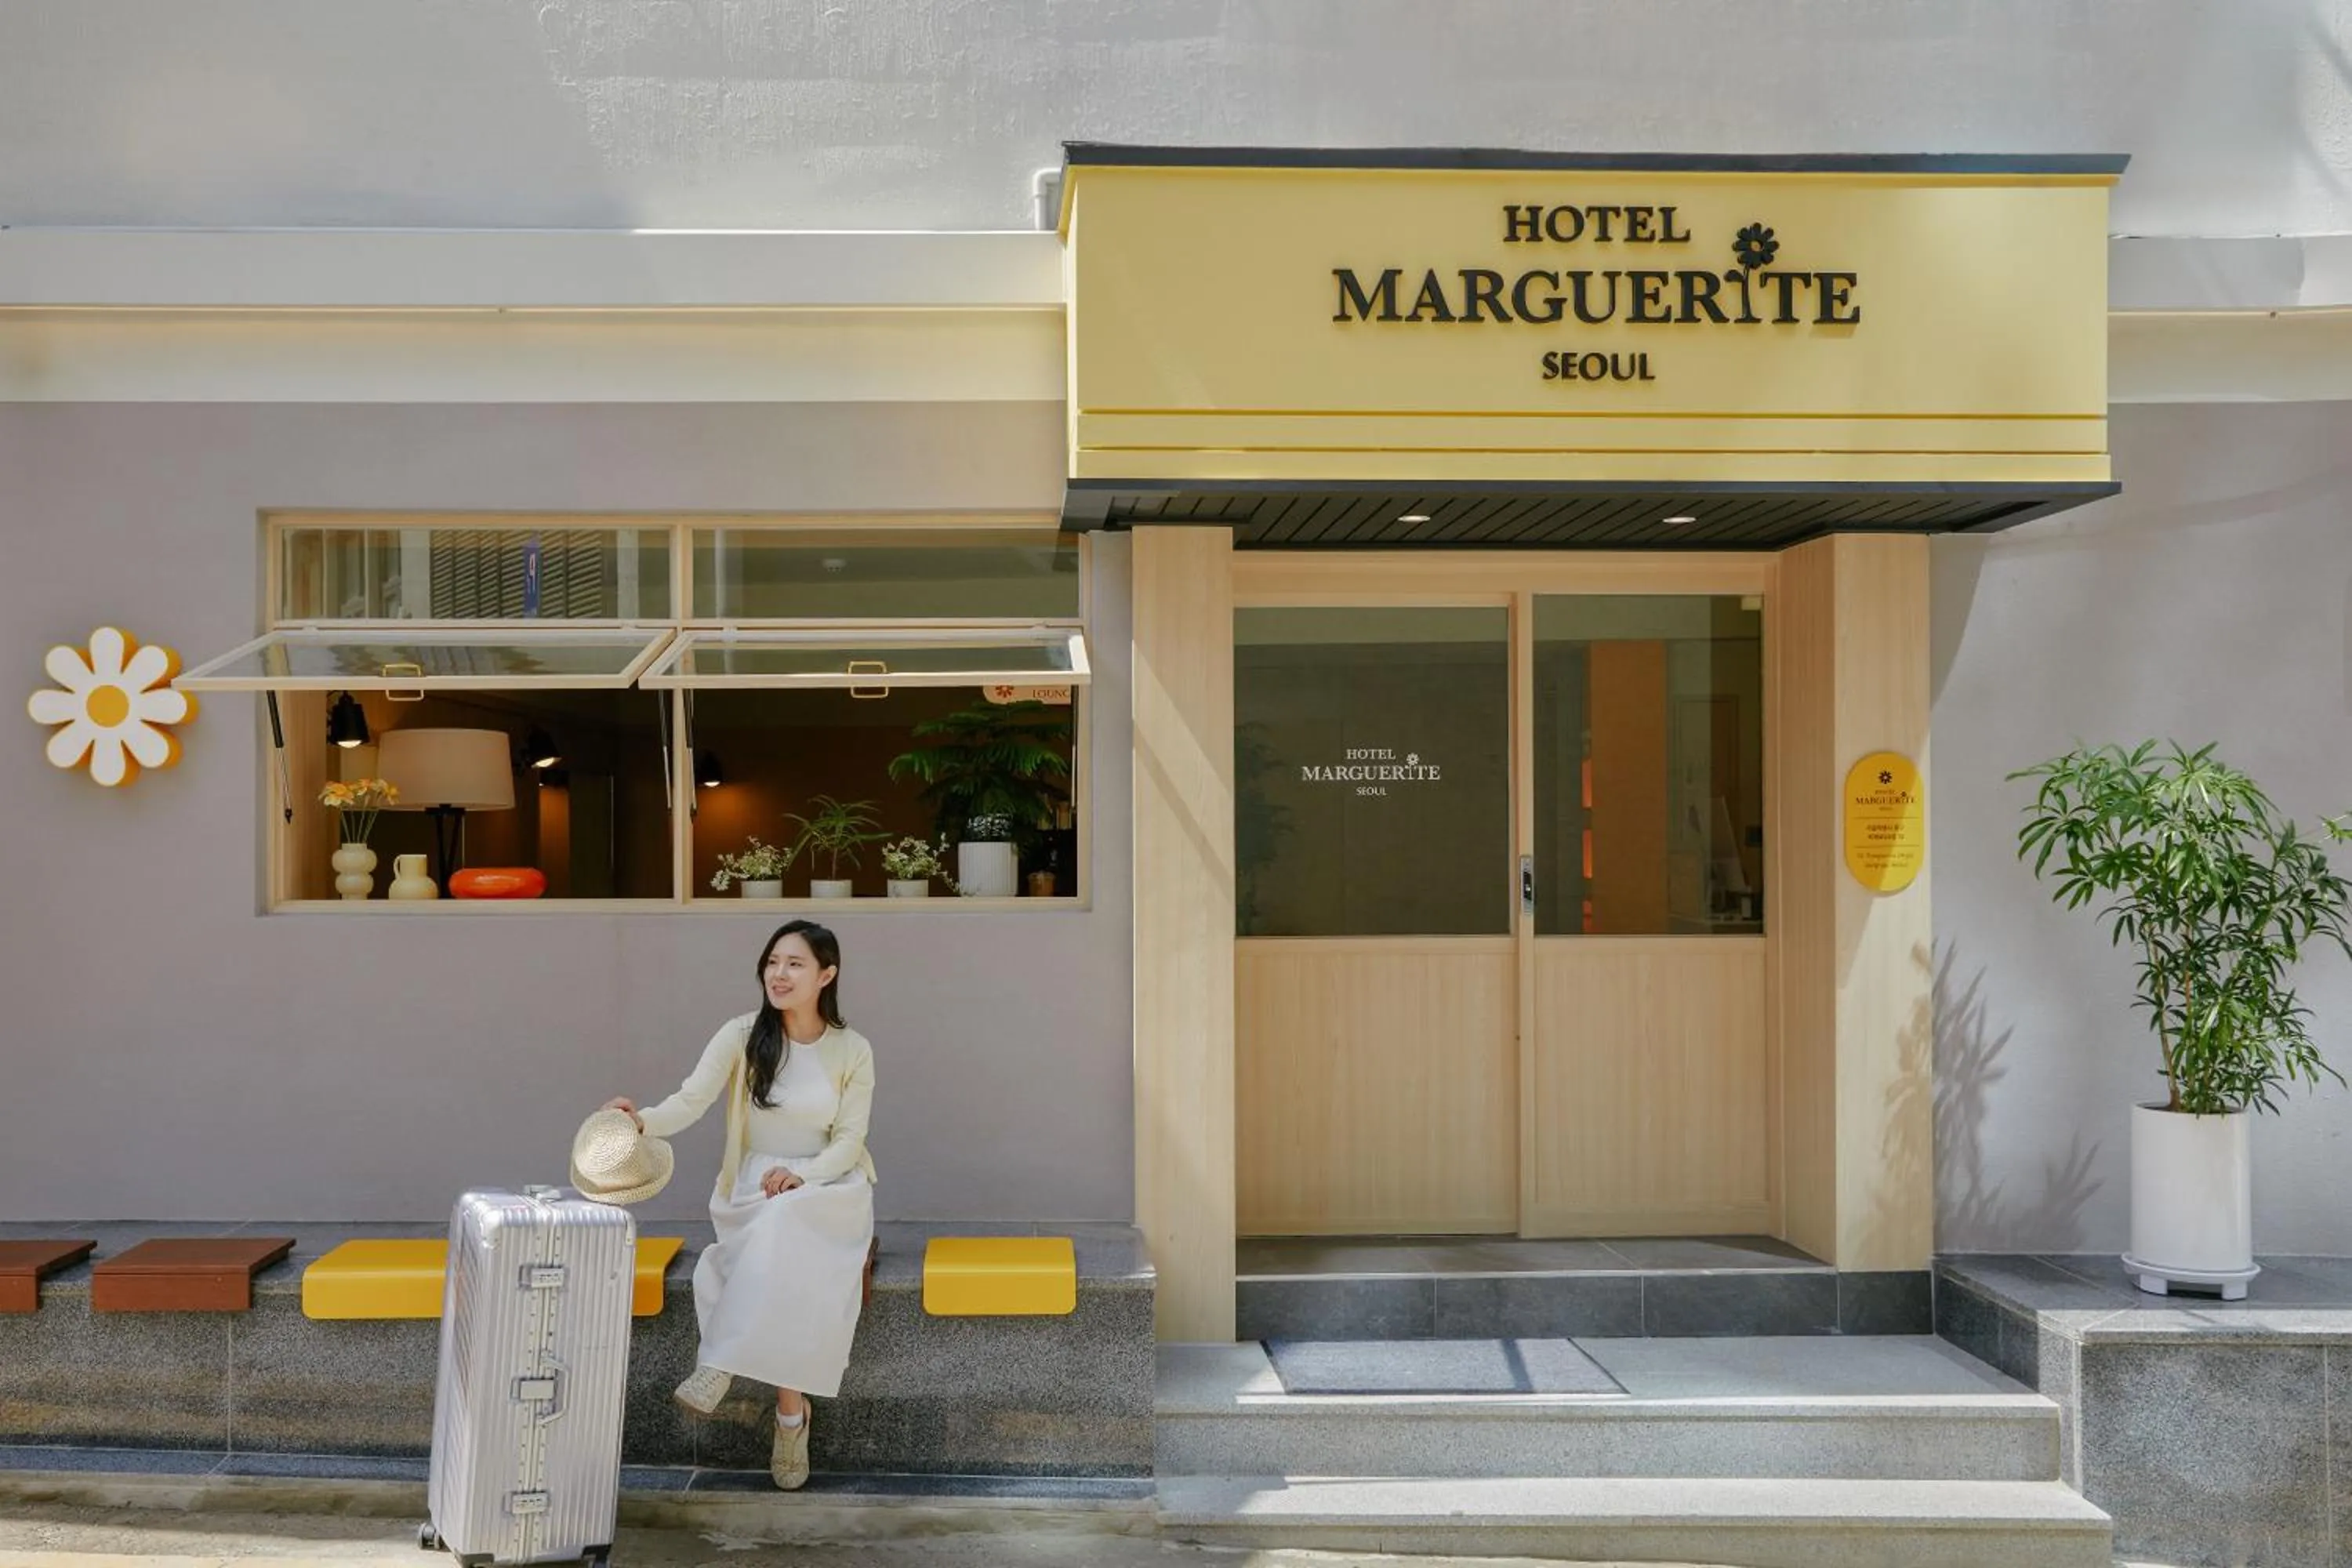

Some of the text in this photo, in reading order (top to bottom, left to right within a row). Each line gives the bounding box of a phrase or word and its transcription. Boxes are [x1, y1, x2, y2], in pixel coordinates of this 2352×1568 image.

[1503, 205, 1690, 243] HOTEL
[1332, 265, 1860, 325] MARGUERITE
[1542, 351, 1655, 381] SEOUL
[1346, 749, 1396, 760] HOTEL
[1301, 764, 1440, 781] MARGUERITE
[1356, 786, 1387, 796] SEOUL
